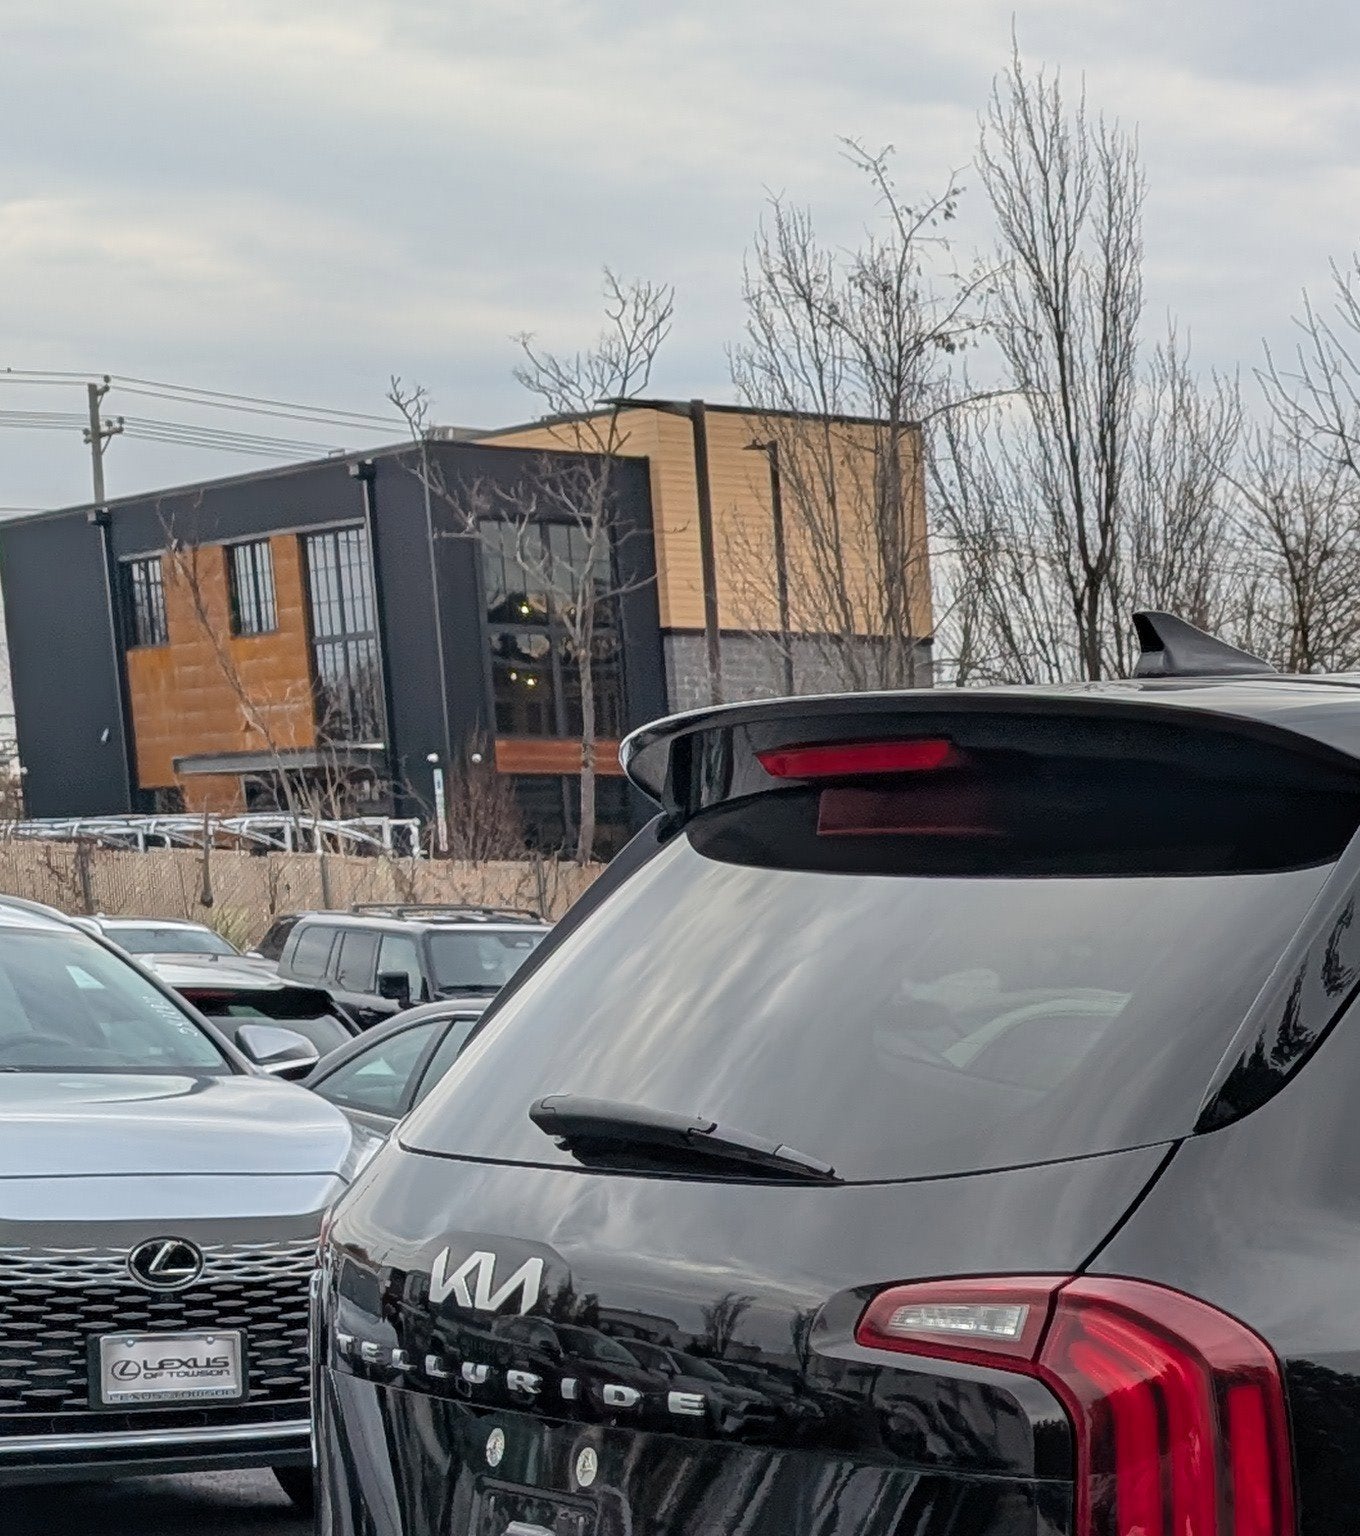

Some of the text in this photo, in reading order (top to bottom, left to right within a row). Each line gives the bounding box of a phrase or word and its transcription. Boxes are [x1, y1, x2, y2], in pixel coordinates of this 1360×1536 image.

[142, 1356, 230, 1370] LEXUS
[142, 1372, 163, 1380] OF
[336, 1332, 705, 1417] TELLURIDE
